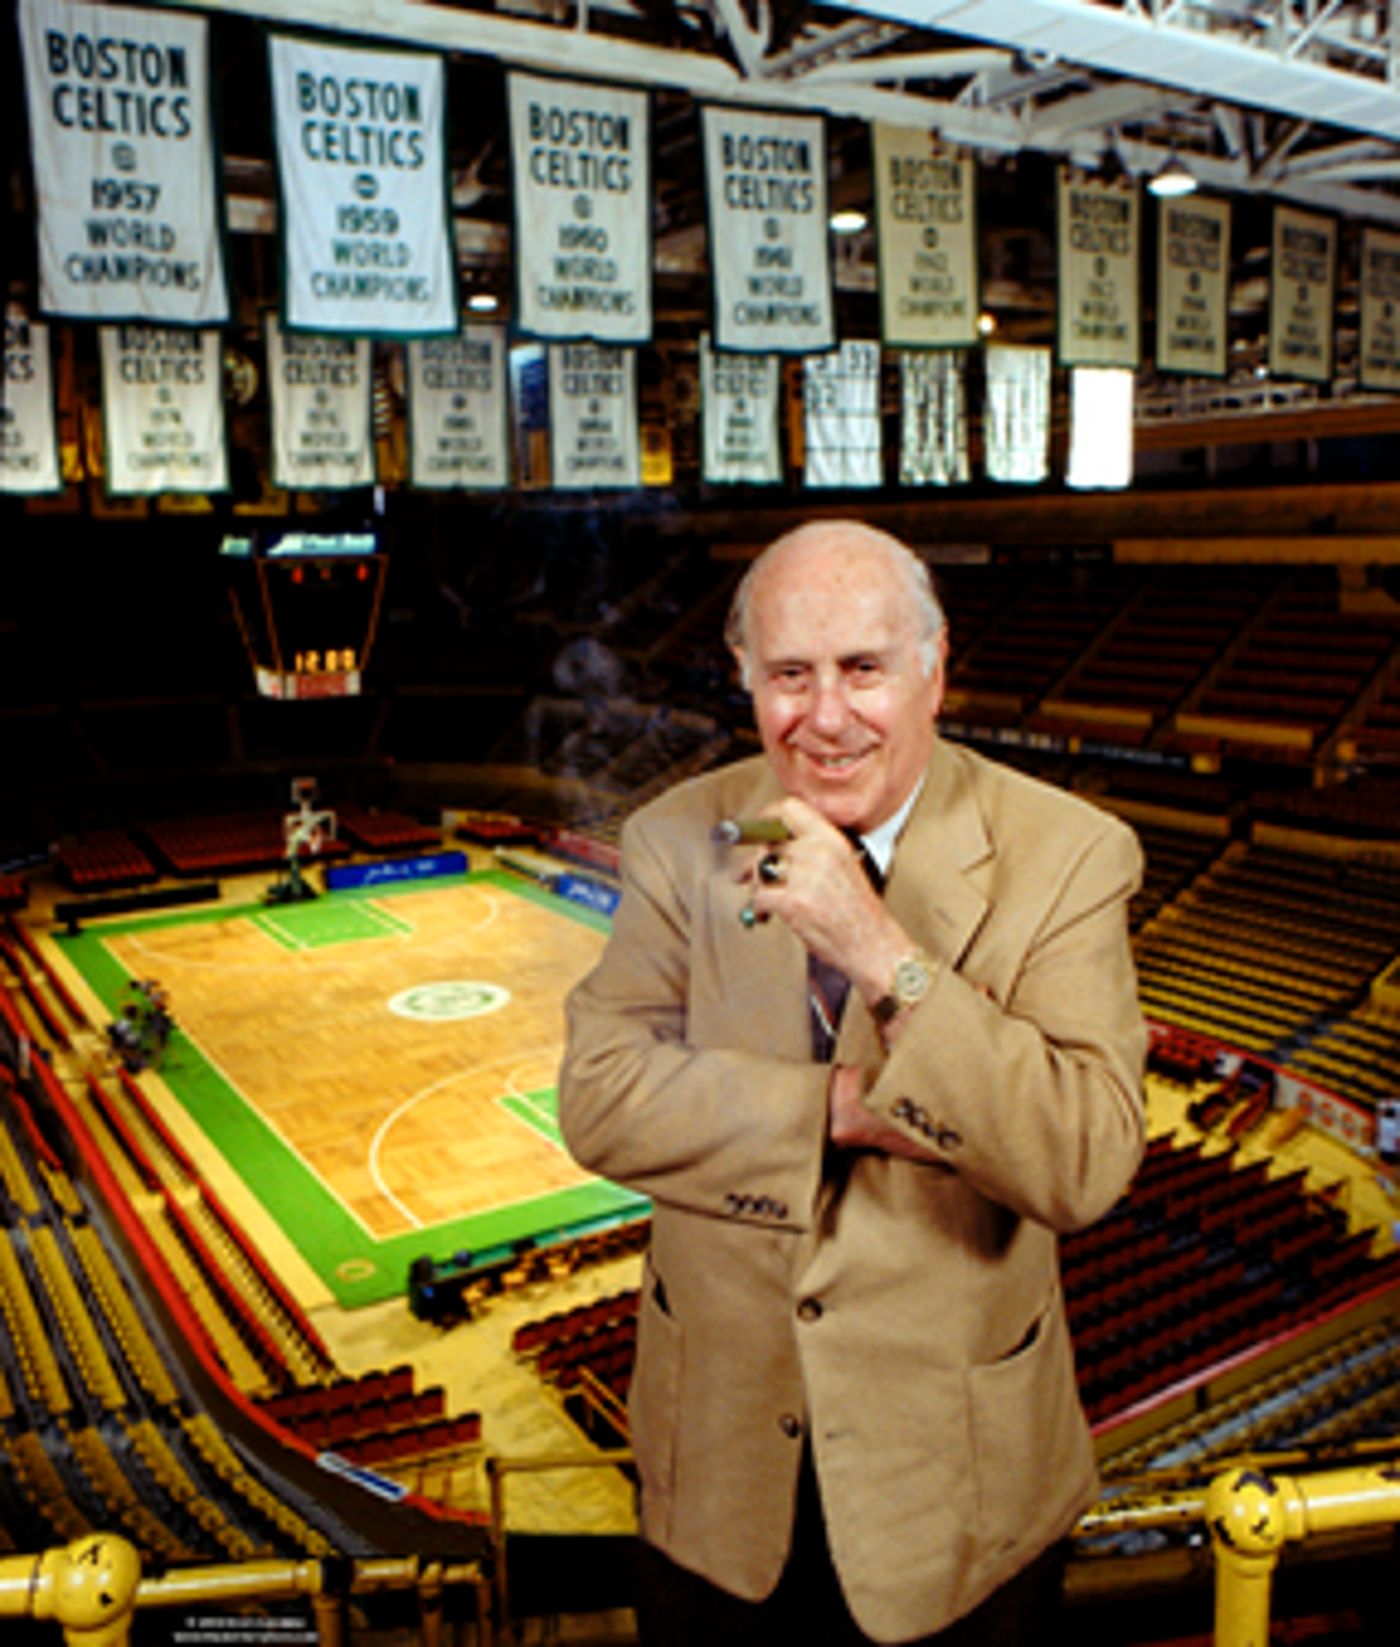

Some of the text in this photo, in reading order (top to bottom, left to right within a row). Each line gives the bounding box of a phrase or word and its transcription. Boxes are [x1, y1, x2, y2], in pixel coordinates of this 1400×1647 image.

[45, 29, 188, 89] BOSTON
[51, 84, 192, 138] CELTICS
[296, 71, 421, 122] BOSTON
[302, 121, 425, 170] CELTICS
[528, 101, 630, 150] BOSTON
[530, 147, 631, 193] CELTICS
[721, 132, 811, 173] BOSTON
[91, 178, 161, 211] 1957
[723, 174, 813, 215] CELTICS
[85, 218, 177, 253] WORLD
[337, 205, 399, 236] 1959
[63, 253, 200, 292] CHAMPIONS
[331, 239, 410, 268] WORLD
[553, 256, 618, 282] WORLD
[311, 272, 429, 302] CHAMPIONS
[119, 354, 205, 385] CELTICS
